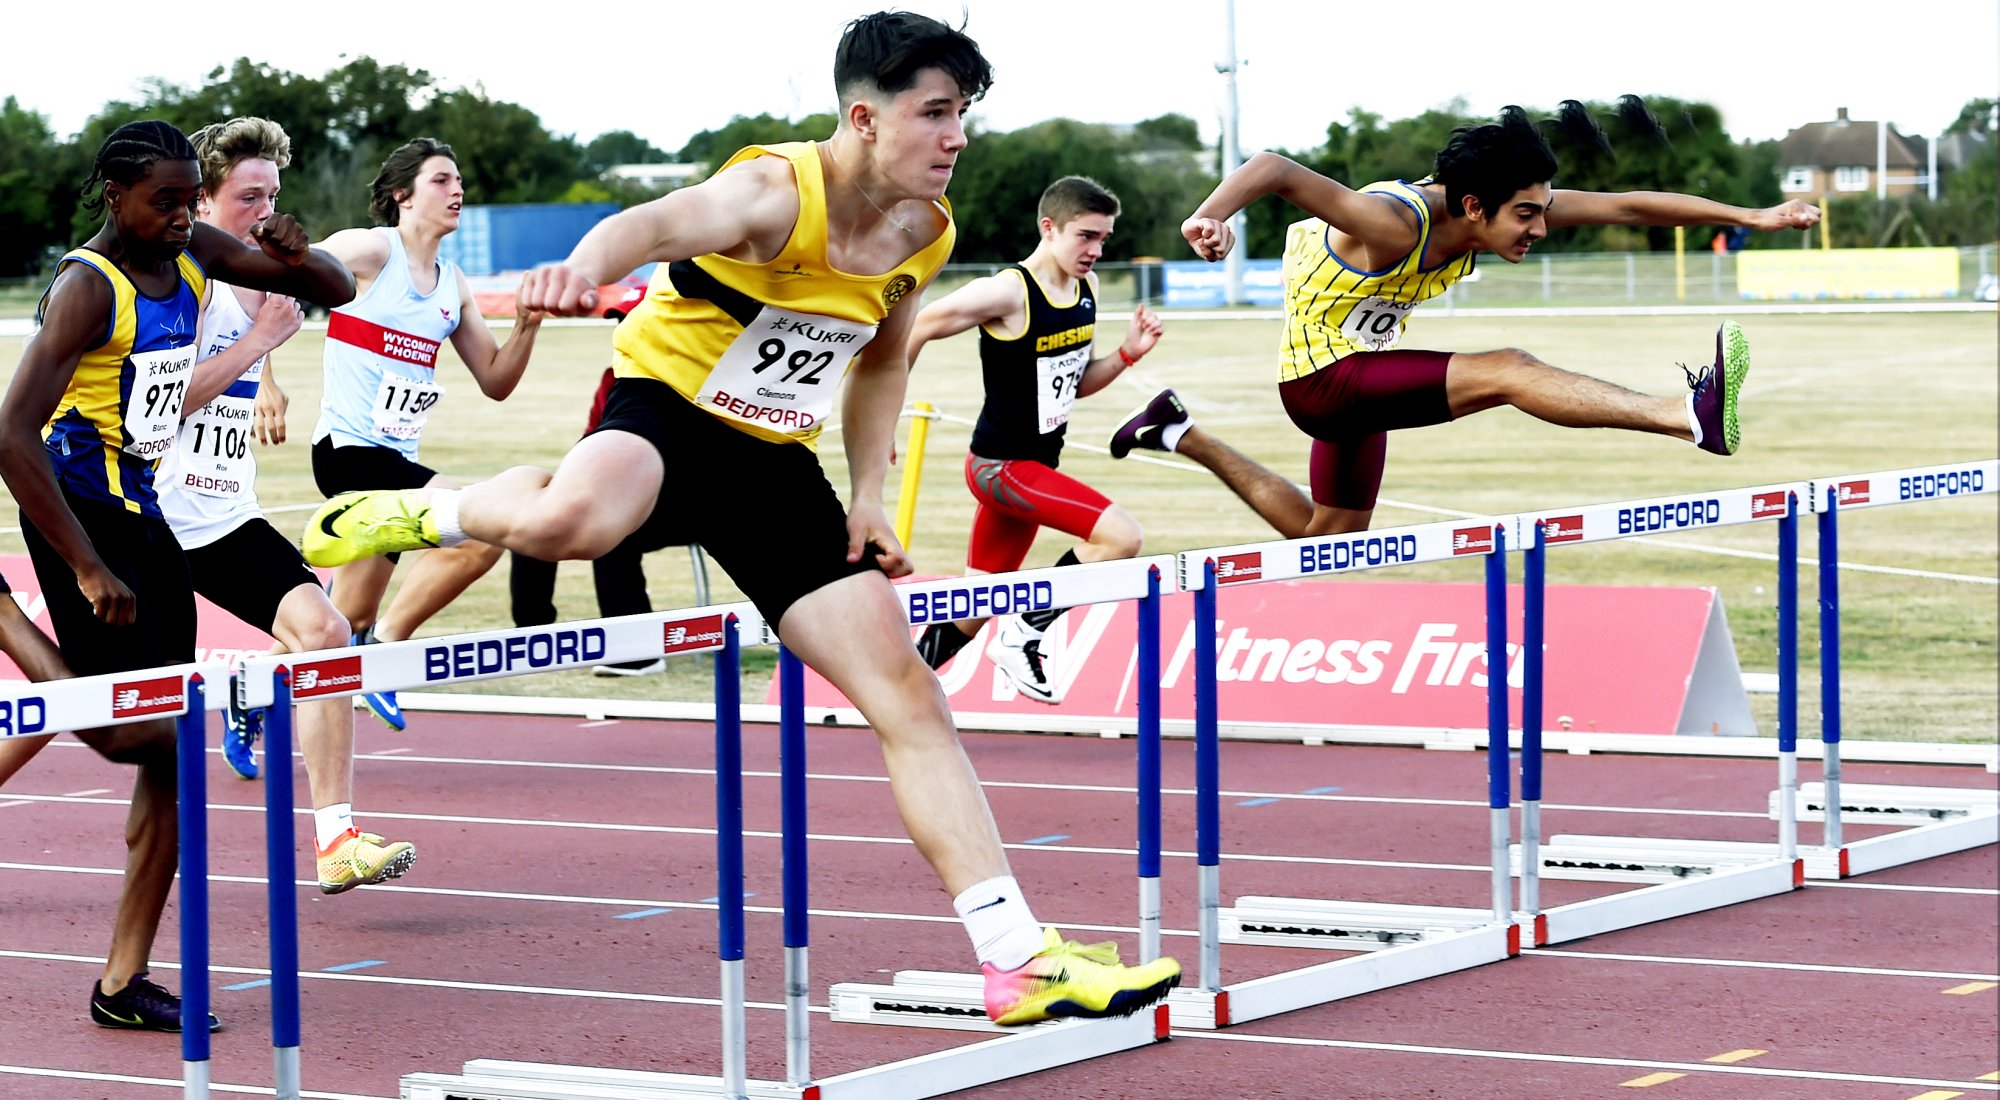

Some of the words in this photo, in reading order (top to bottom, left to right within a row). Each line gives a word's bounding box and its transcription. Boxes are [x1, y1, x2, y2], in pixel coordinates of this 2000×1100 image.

[789, 321, 858, 344] KUKRI
[158, 357, 191, 375] KUKRI
[752, 338, 834, 386] 992
[144, 379, 185, 419] 973
[712, 390, 815, 429] BEDFORD
[756, 386, 797, 401] Clemons
[215, 404, 250, 421] KUKRI
[193, 422, 247, 460] 1106
[185, 473, 240, 493] BEDFORD
[1900, 469, 1984, 501] BEDFORD
[1618, 498, 1720, 535] BEDFORD
[1300, 534, 1417, 574] BEDFORD
[909, 580, 1052, 624] BEDFORD
[424, 627, 607, 682] BEDFORD
